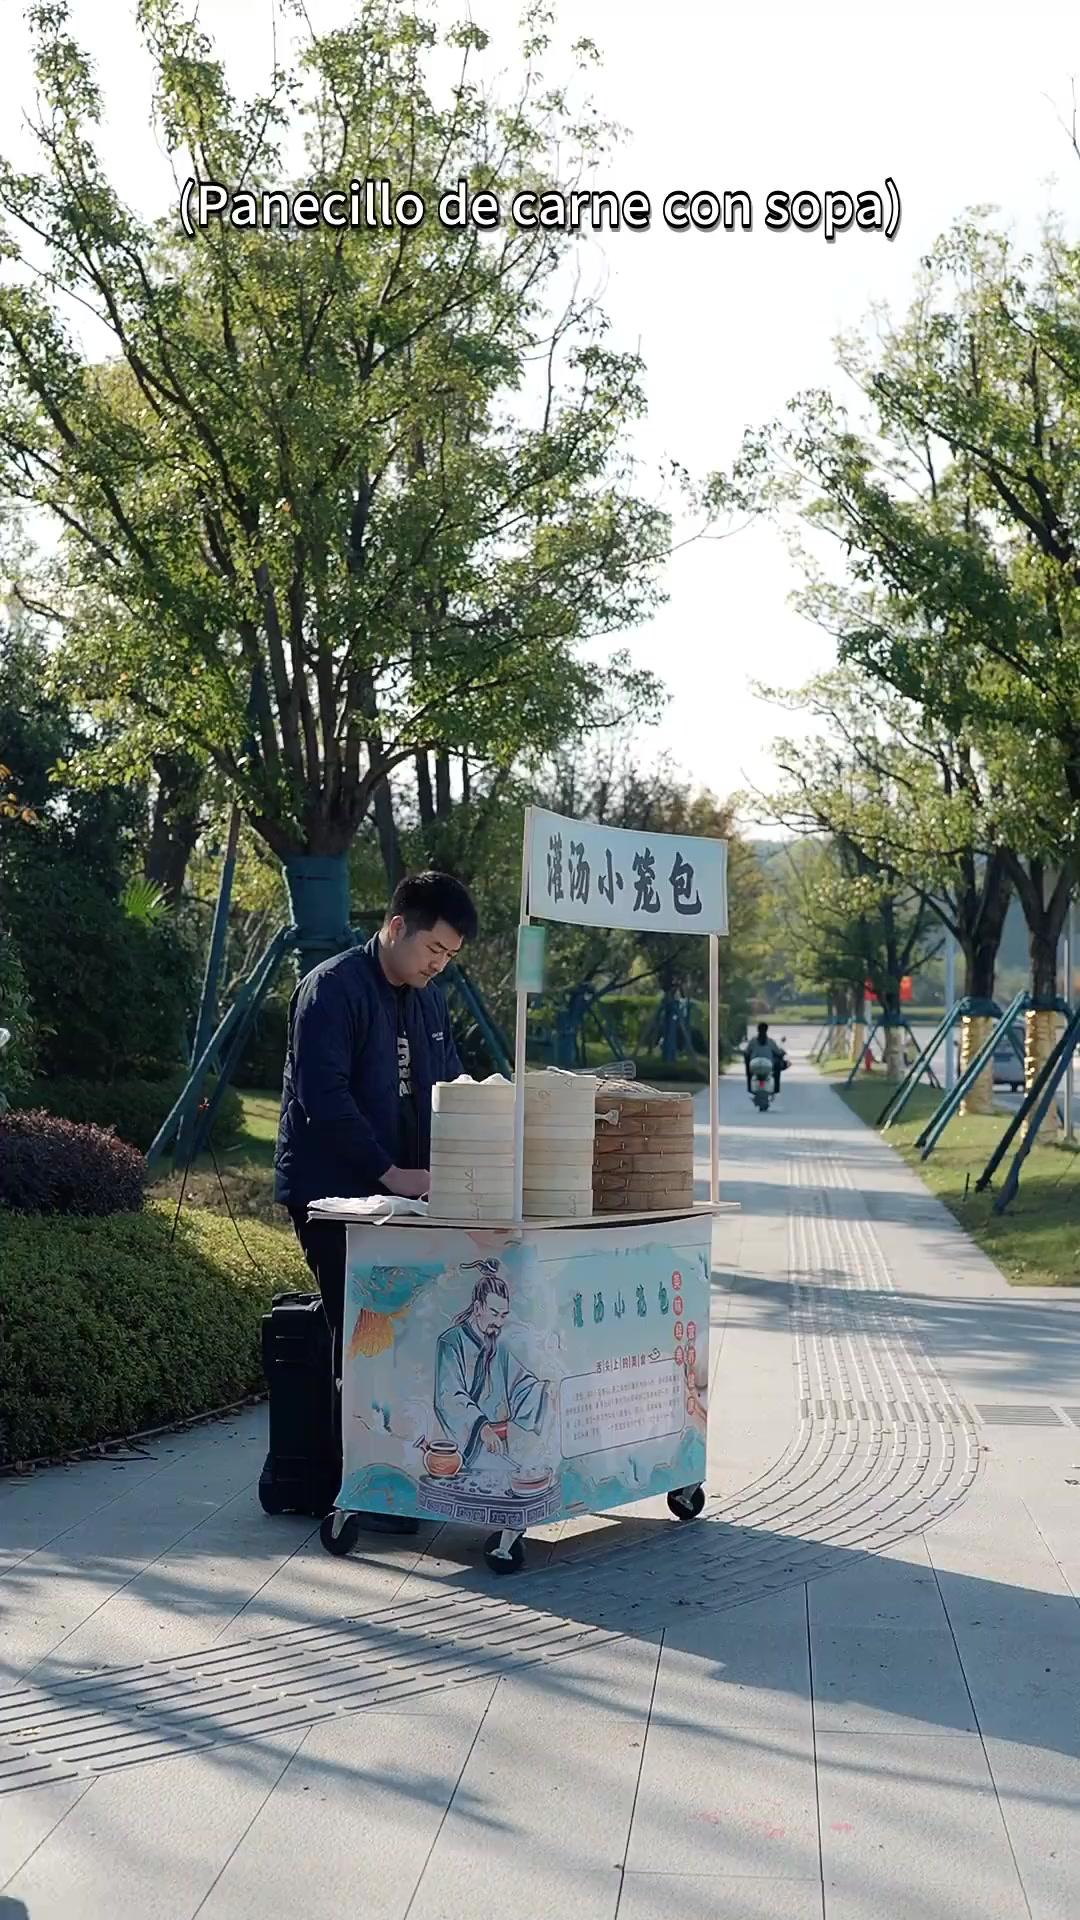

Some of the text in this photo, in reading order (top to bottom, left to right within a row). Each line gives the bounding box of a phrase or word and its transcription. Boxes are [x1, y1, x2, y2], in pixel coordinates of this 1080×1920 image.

[547, 831, 703, 915] 灌汤小笼包
